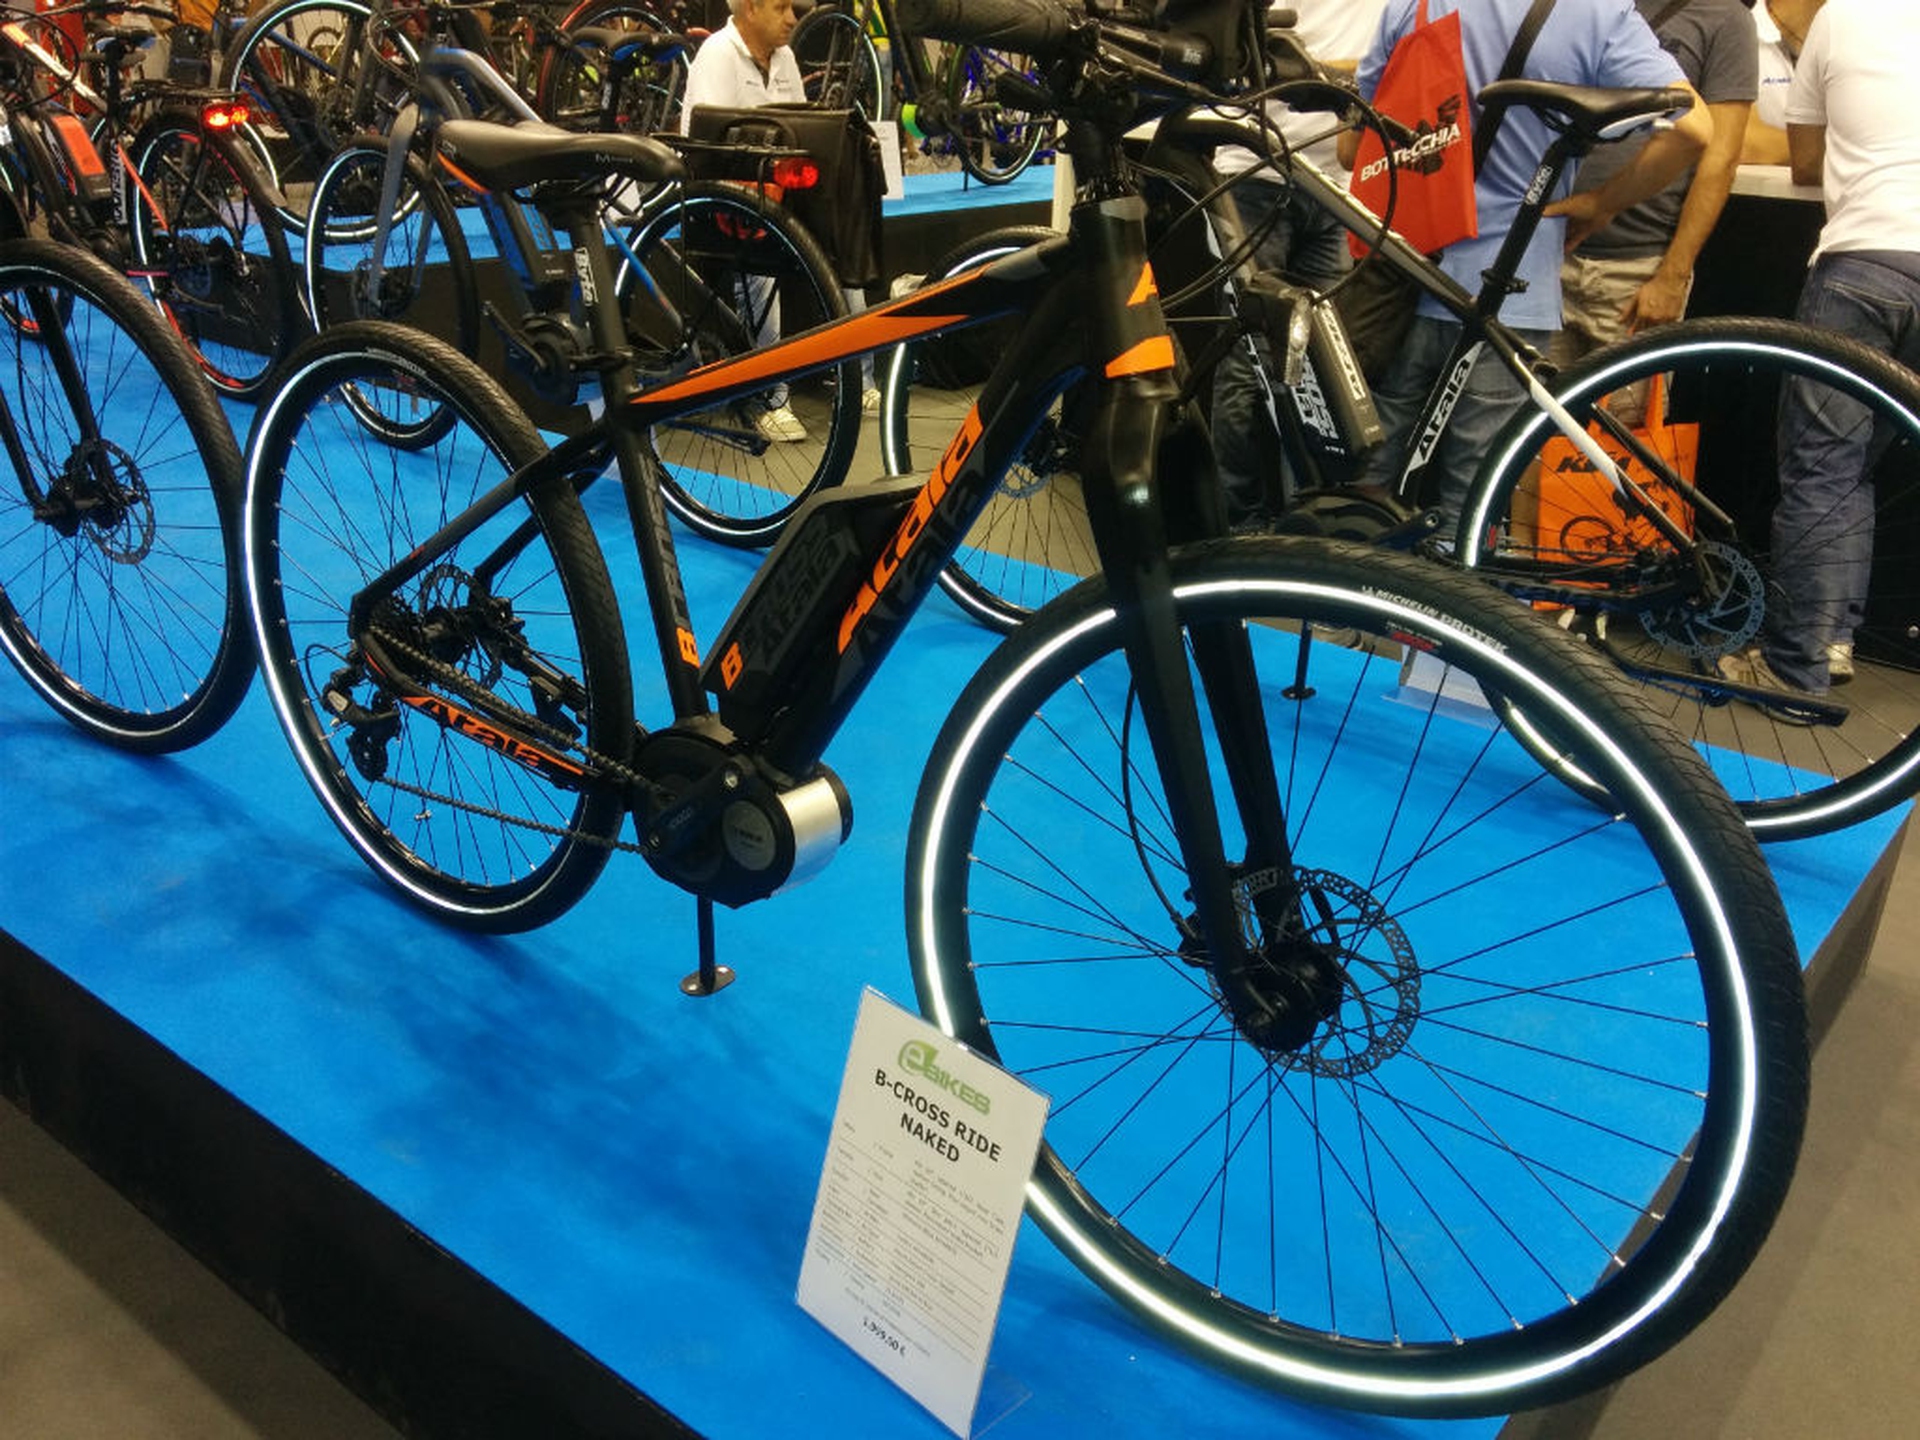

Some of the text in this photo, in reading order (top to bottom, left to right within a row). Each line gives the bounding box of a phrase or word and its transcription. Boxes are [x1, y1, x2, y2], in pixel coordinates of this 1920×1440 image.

[1375, 589, 1439, 618] MICHELIN
[1440, 613, 1509, 655] PROTEK
[875, 1069, 1003, 1163] B-CROSS RIDE
[900, 1113, 960, 1163] NAKED
